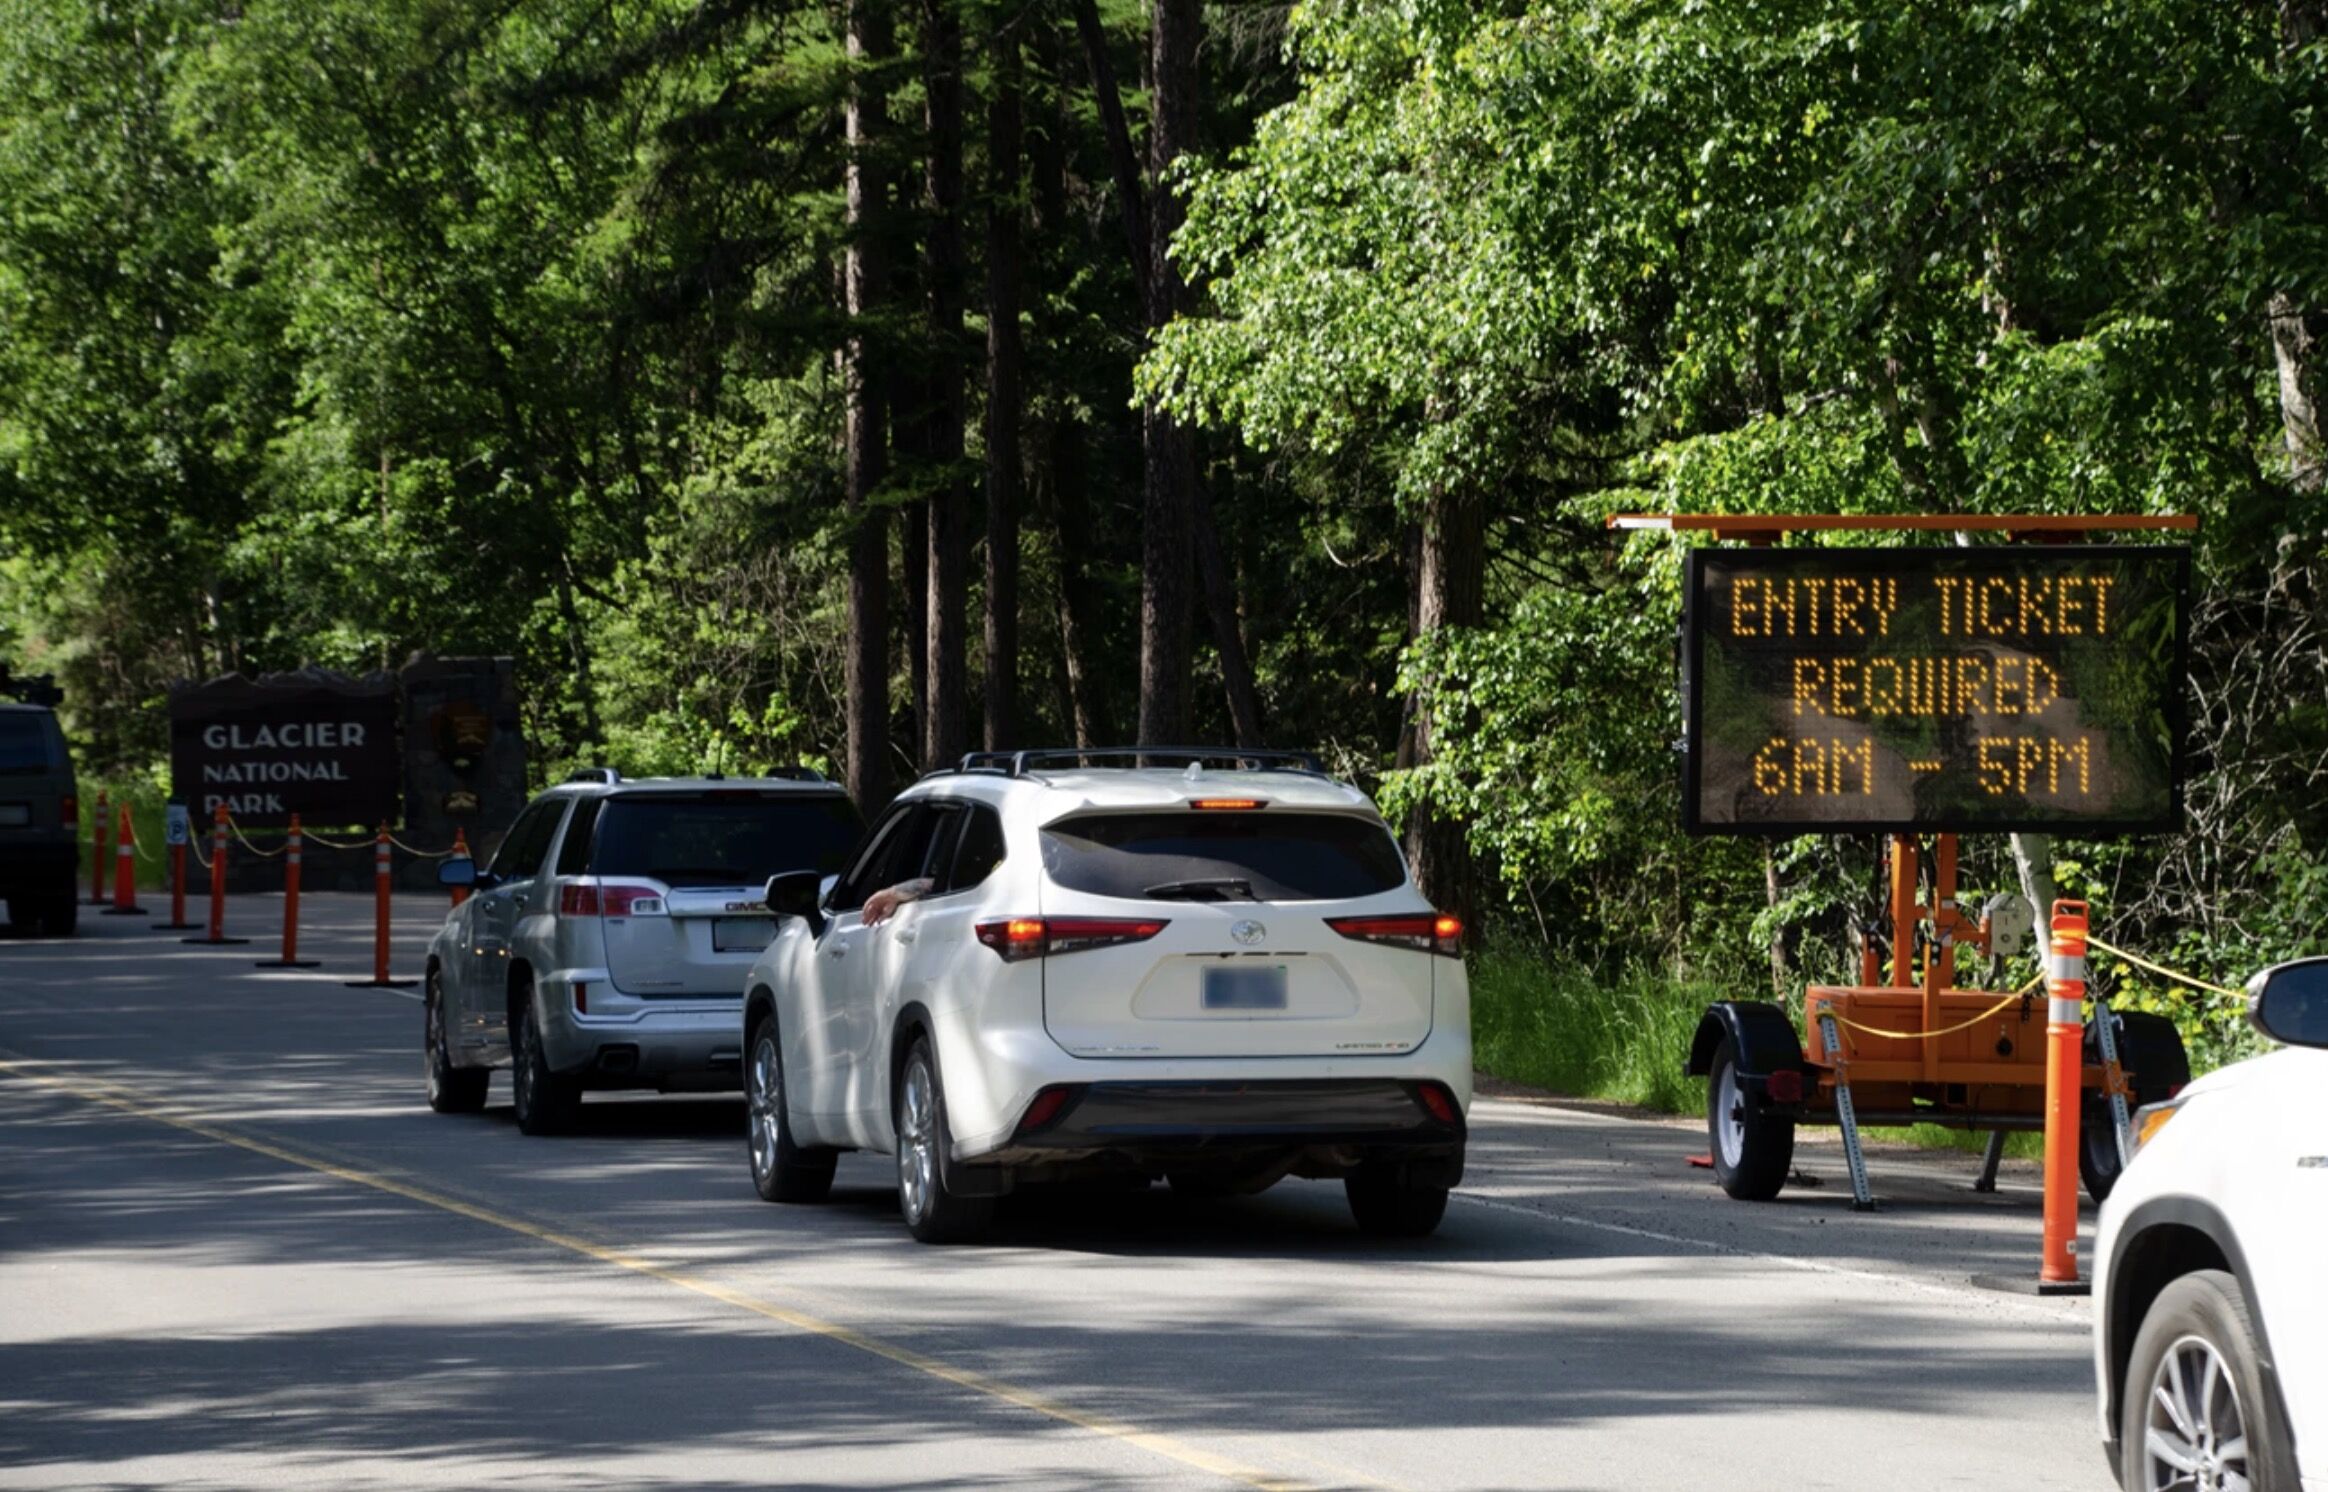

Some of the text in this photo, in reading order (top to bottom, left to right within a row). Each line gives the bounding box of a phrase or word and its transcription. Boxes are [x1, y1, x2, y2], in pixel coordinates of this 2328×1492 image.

[1731, 577, 2115, 637] ENTRY TICKET
[1792, 657, 2060, 717] REQUIRED
[203, 722, 366, 749] GLACIER
[203, 761, 348, 782] NATIONAL
[1753, 736, 1873, 796] 6AM
[1977, 736, 2090, 794] 5PM
[204, 794, 285, 814] PARK
[725, 902, 767, 912] GMC
